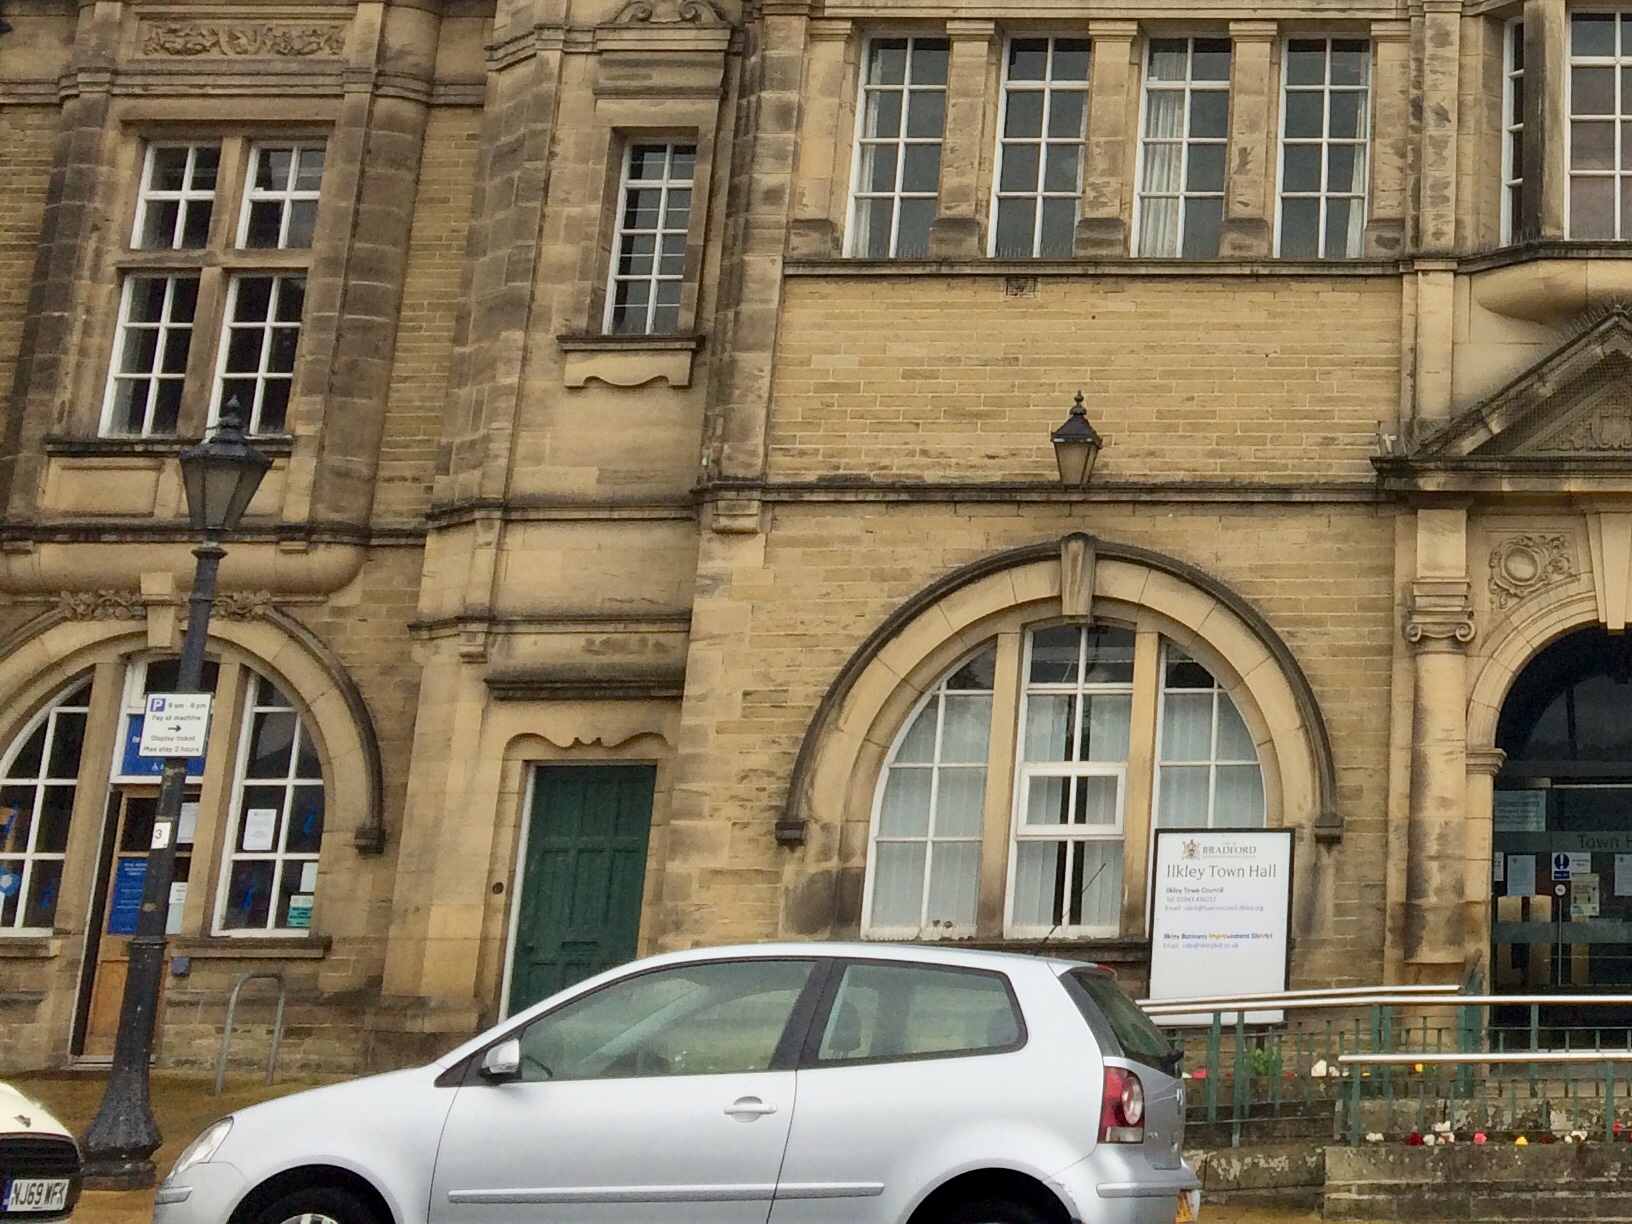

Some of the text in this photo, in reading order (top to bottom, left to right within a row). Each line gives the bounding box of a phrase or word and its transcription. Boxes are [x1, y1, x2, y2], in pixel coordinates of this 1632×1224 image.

[155, 829, 162, 839] 3
[1577, 835, 1619, 849] Town
[1167, 864, 1276, 880] Ilkley Town Hall
[11, 1183, 44, 1205] NJ69
